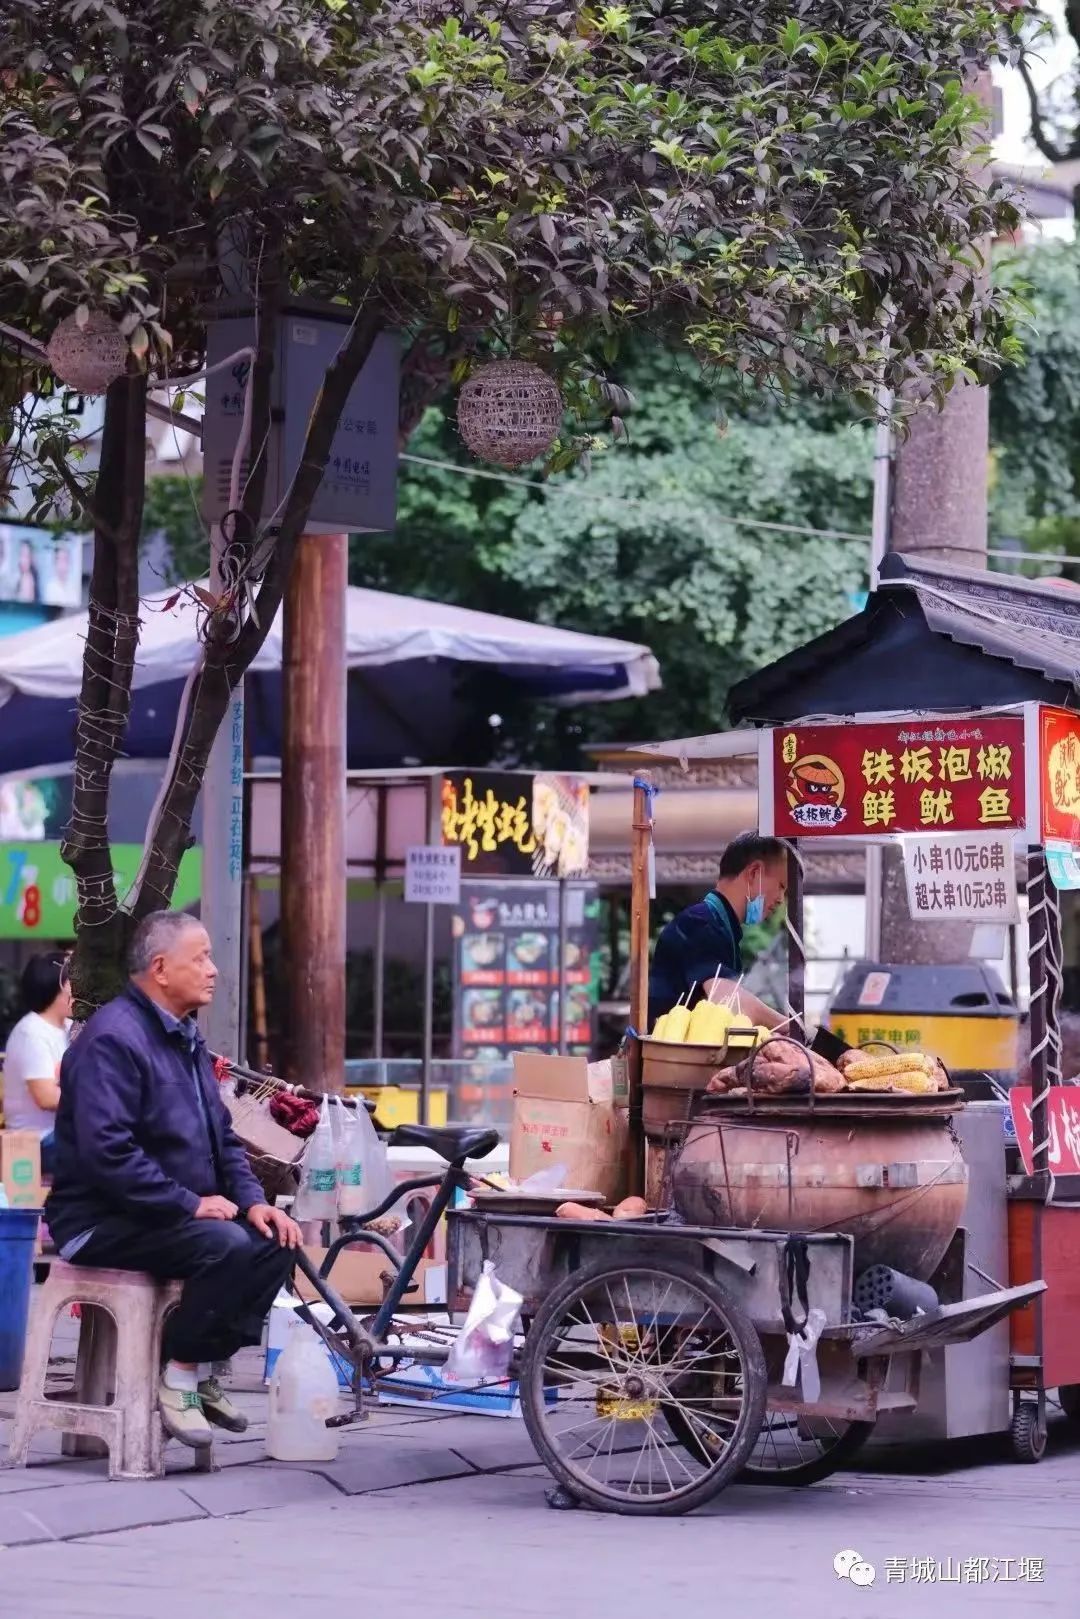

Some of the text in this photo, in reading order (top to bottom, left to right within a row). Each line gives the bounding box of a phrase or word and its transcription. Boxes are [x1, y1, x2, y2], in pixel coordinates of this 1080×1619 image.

[860, 743, 1013, 786] 铁板泡椒
[793, 806, 843, 823] 铁板鱿鱼
[861, 785, 1013, 827] 鲜鱿鱼
[912, 842, 1006, 875] 小串10元6串
[914, 881, 1007, 911] 超大串10元3串
[857, 1028, 921, 1045] 国家电网
